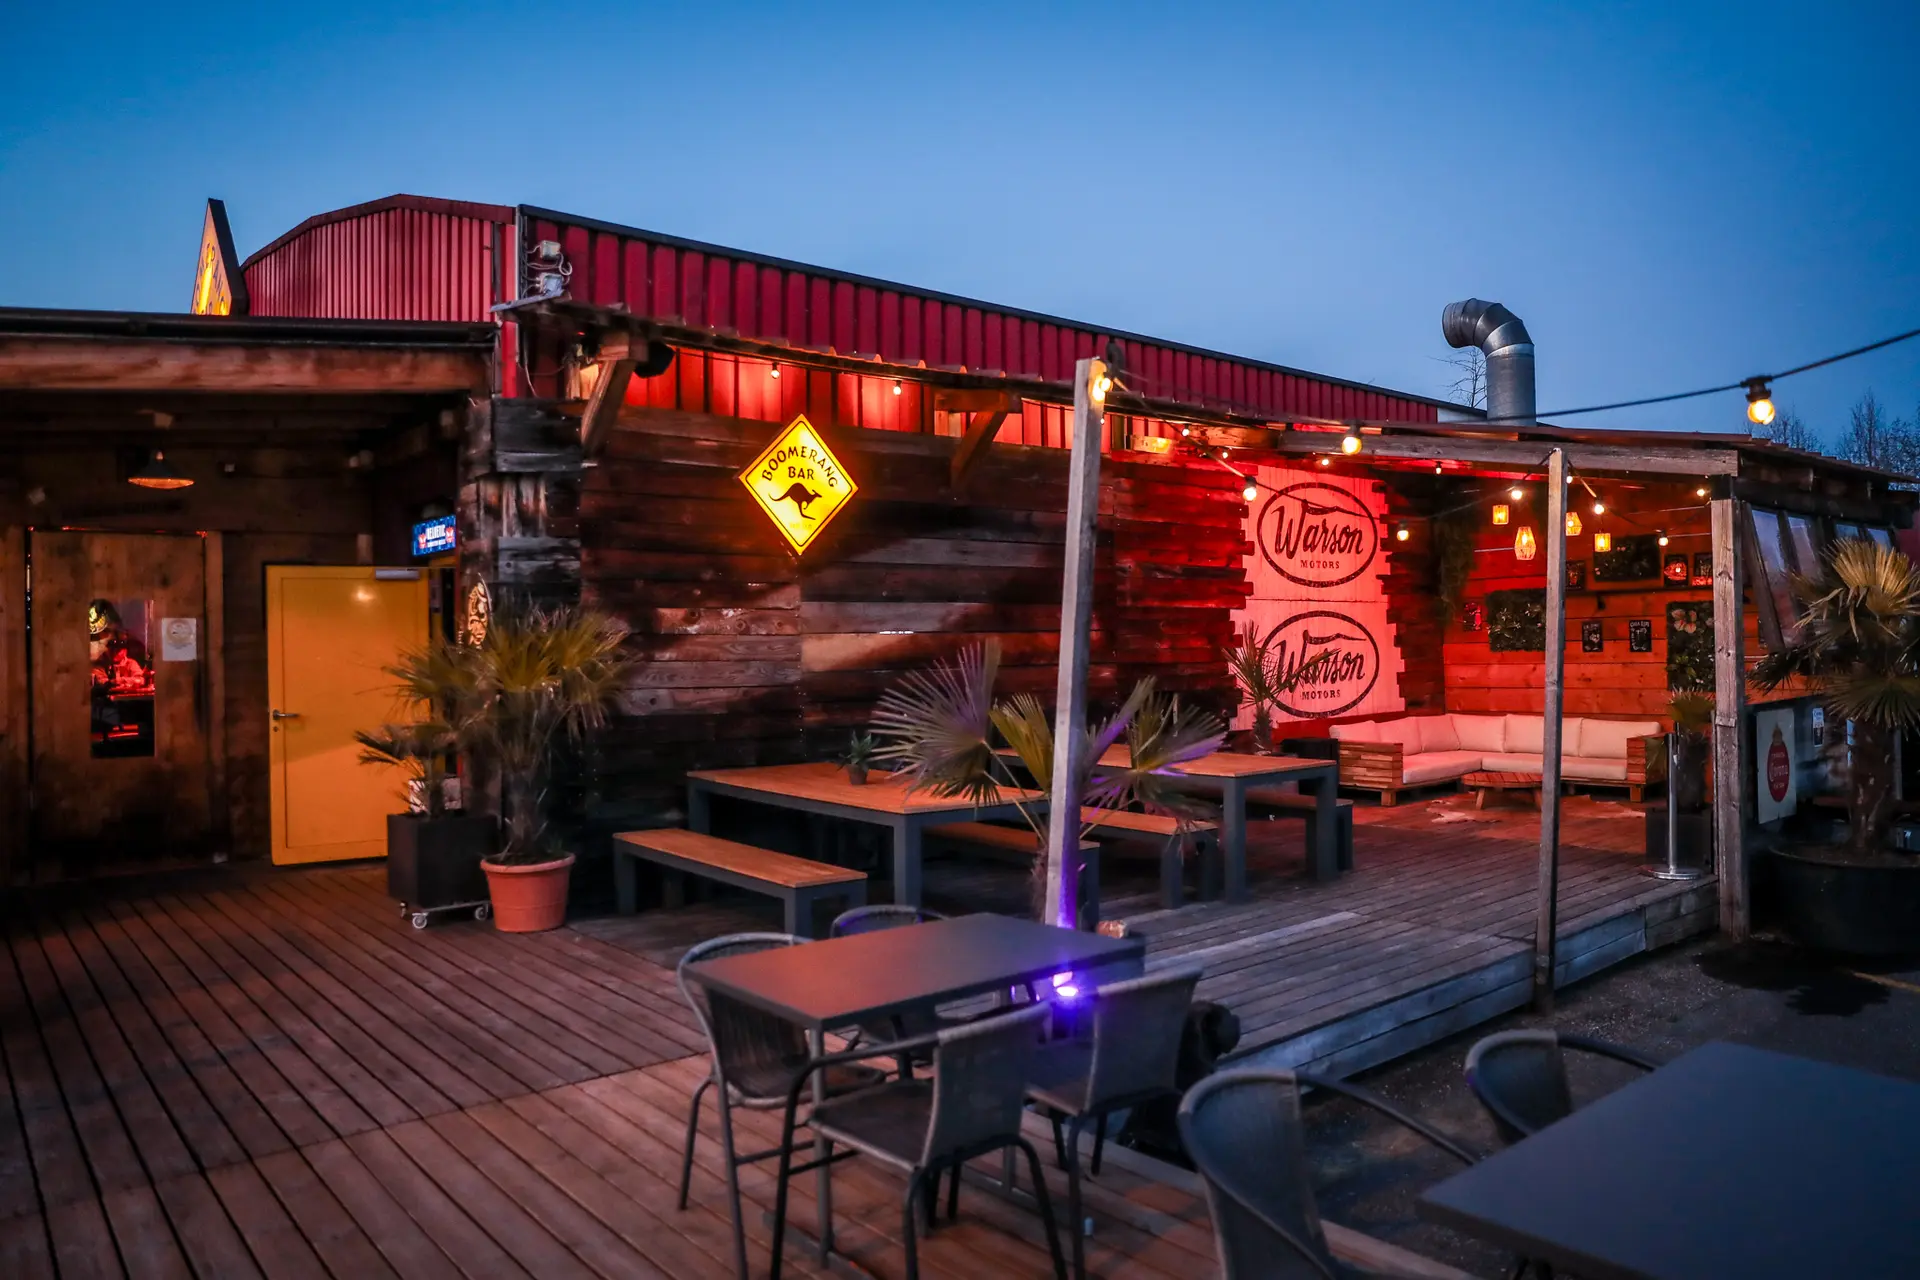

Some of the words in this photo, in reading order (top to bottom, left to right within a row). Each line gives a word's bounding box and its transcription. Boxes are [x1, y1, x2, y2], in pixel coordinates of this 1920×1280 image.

[762, 446, 838, 488] BOOMERANG
[787, 466, 815, 480] BAR
[1271, 500, 1366, 559] Warson
[1300, 559, 1340, 569] MOTORS
[1301, 689, 1341, 700] MOTORS
